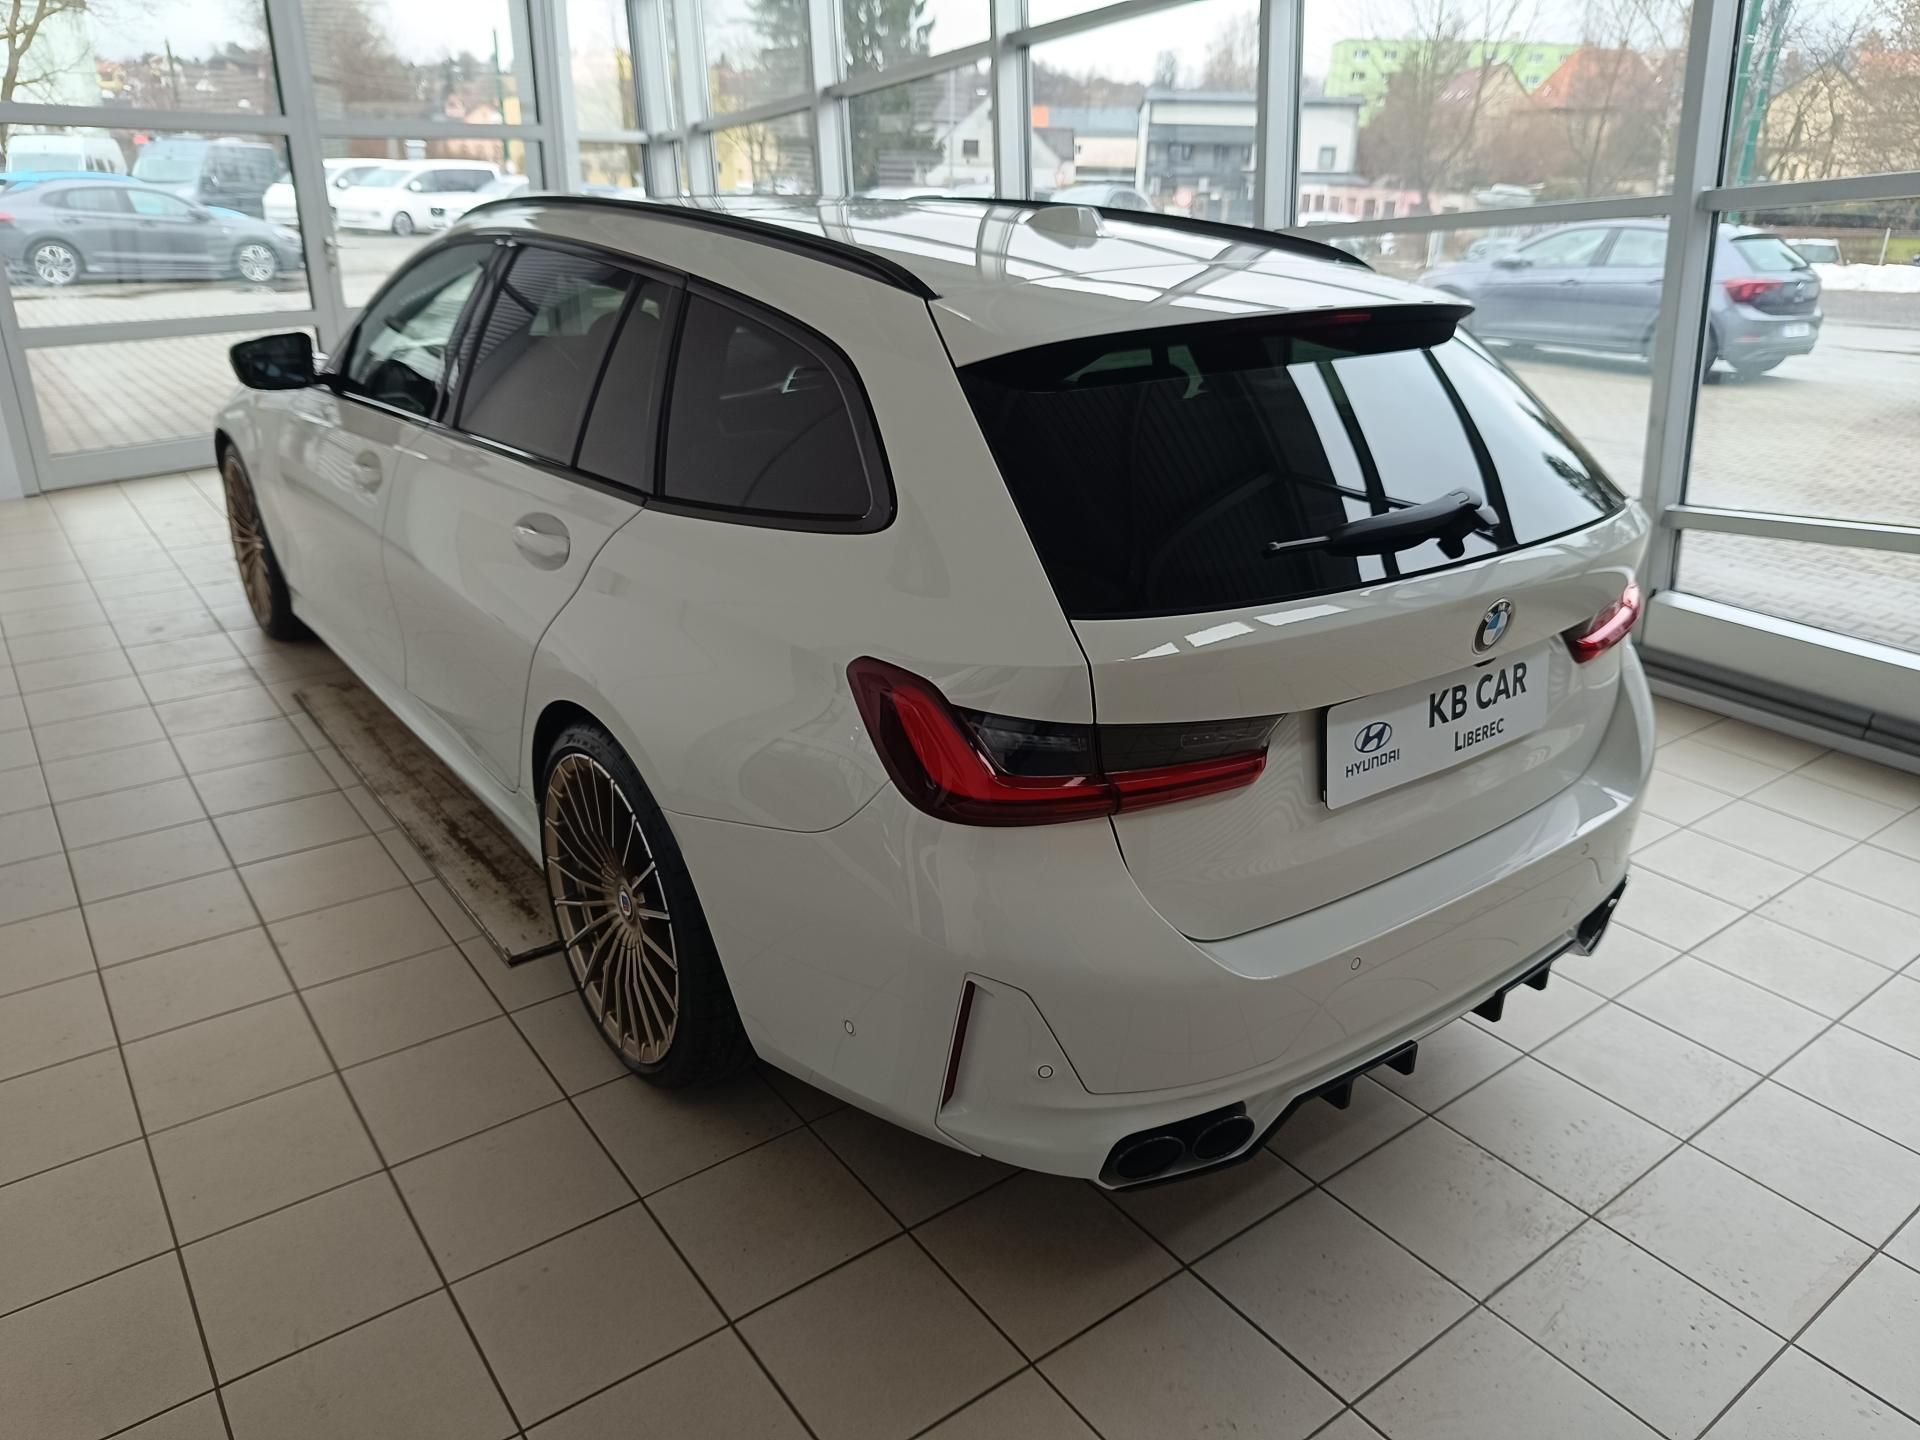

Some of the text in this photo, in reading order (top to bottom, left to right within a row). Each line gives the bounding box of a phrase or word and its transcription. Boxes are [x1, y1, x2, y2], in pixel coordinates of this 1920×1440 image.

[1428, 661, 1527, 728] KB CAR
[1454, 717, 1505, 751] LIBEREC
[1345, 748, 1400, 778] HYUNDAI
